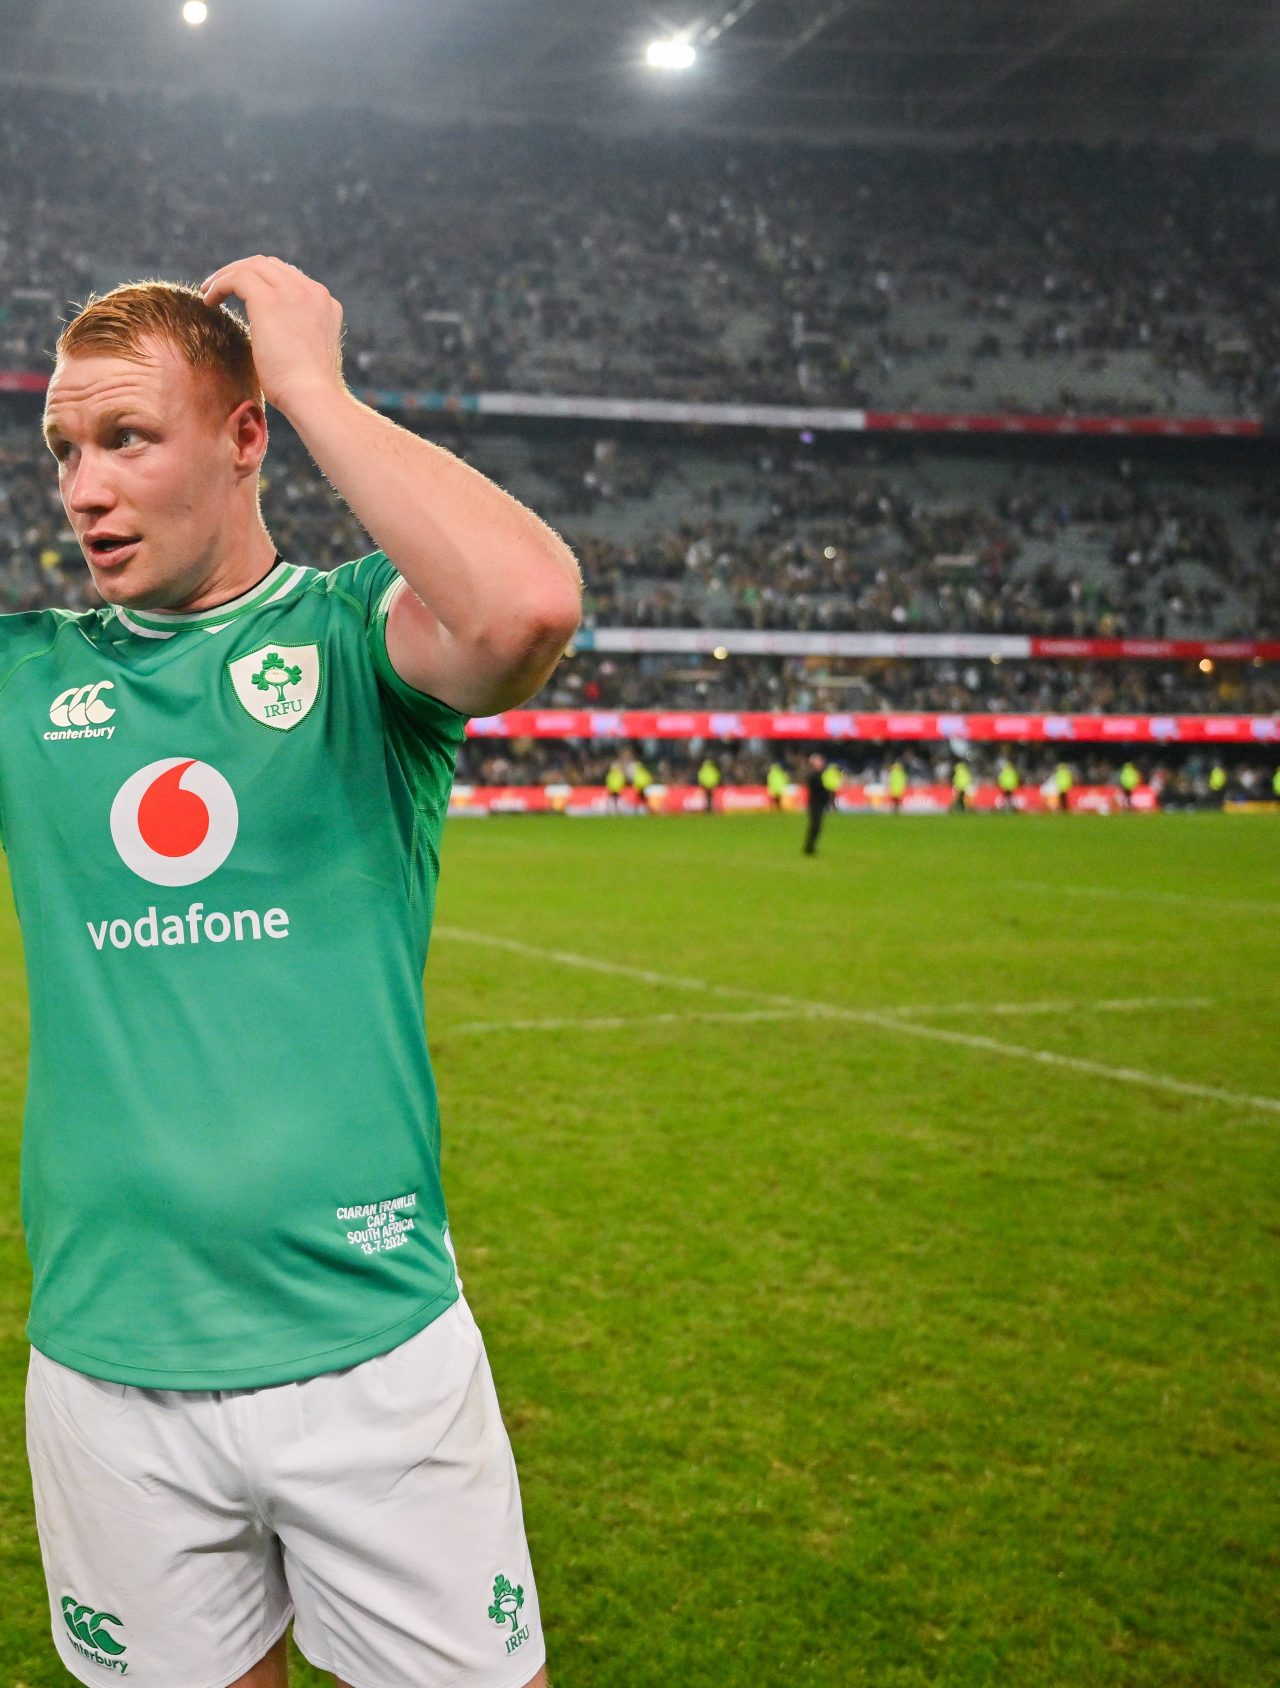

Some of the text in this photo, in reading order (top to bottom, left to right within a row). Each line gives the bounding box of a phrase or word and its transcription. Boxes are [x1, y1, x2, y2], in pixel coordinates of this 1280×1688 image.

[264, 699, 302, 719] IRFU
[43, 725, 116, 741] canterbury
[86, 902, 289, 950] vodafone
[336, 1193, 416, 1219] CIARAN FRAWLEY
[347, 1218, 415, 1244] SOUTH AFRICA
[367, 1211, 396, 1228] CAP 5
[361, 1233, 408, 1254] 13-7-2024
[505, 1624, 530, 1653] IRFU
